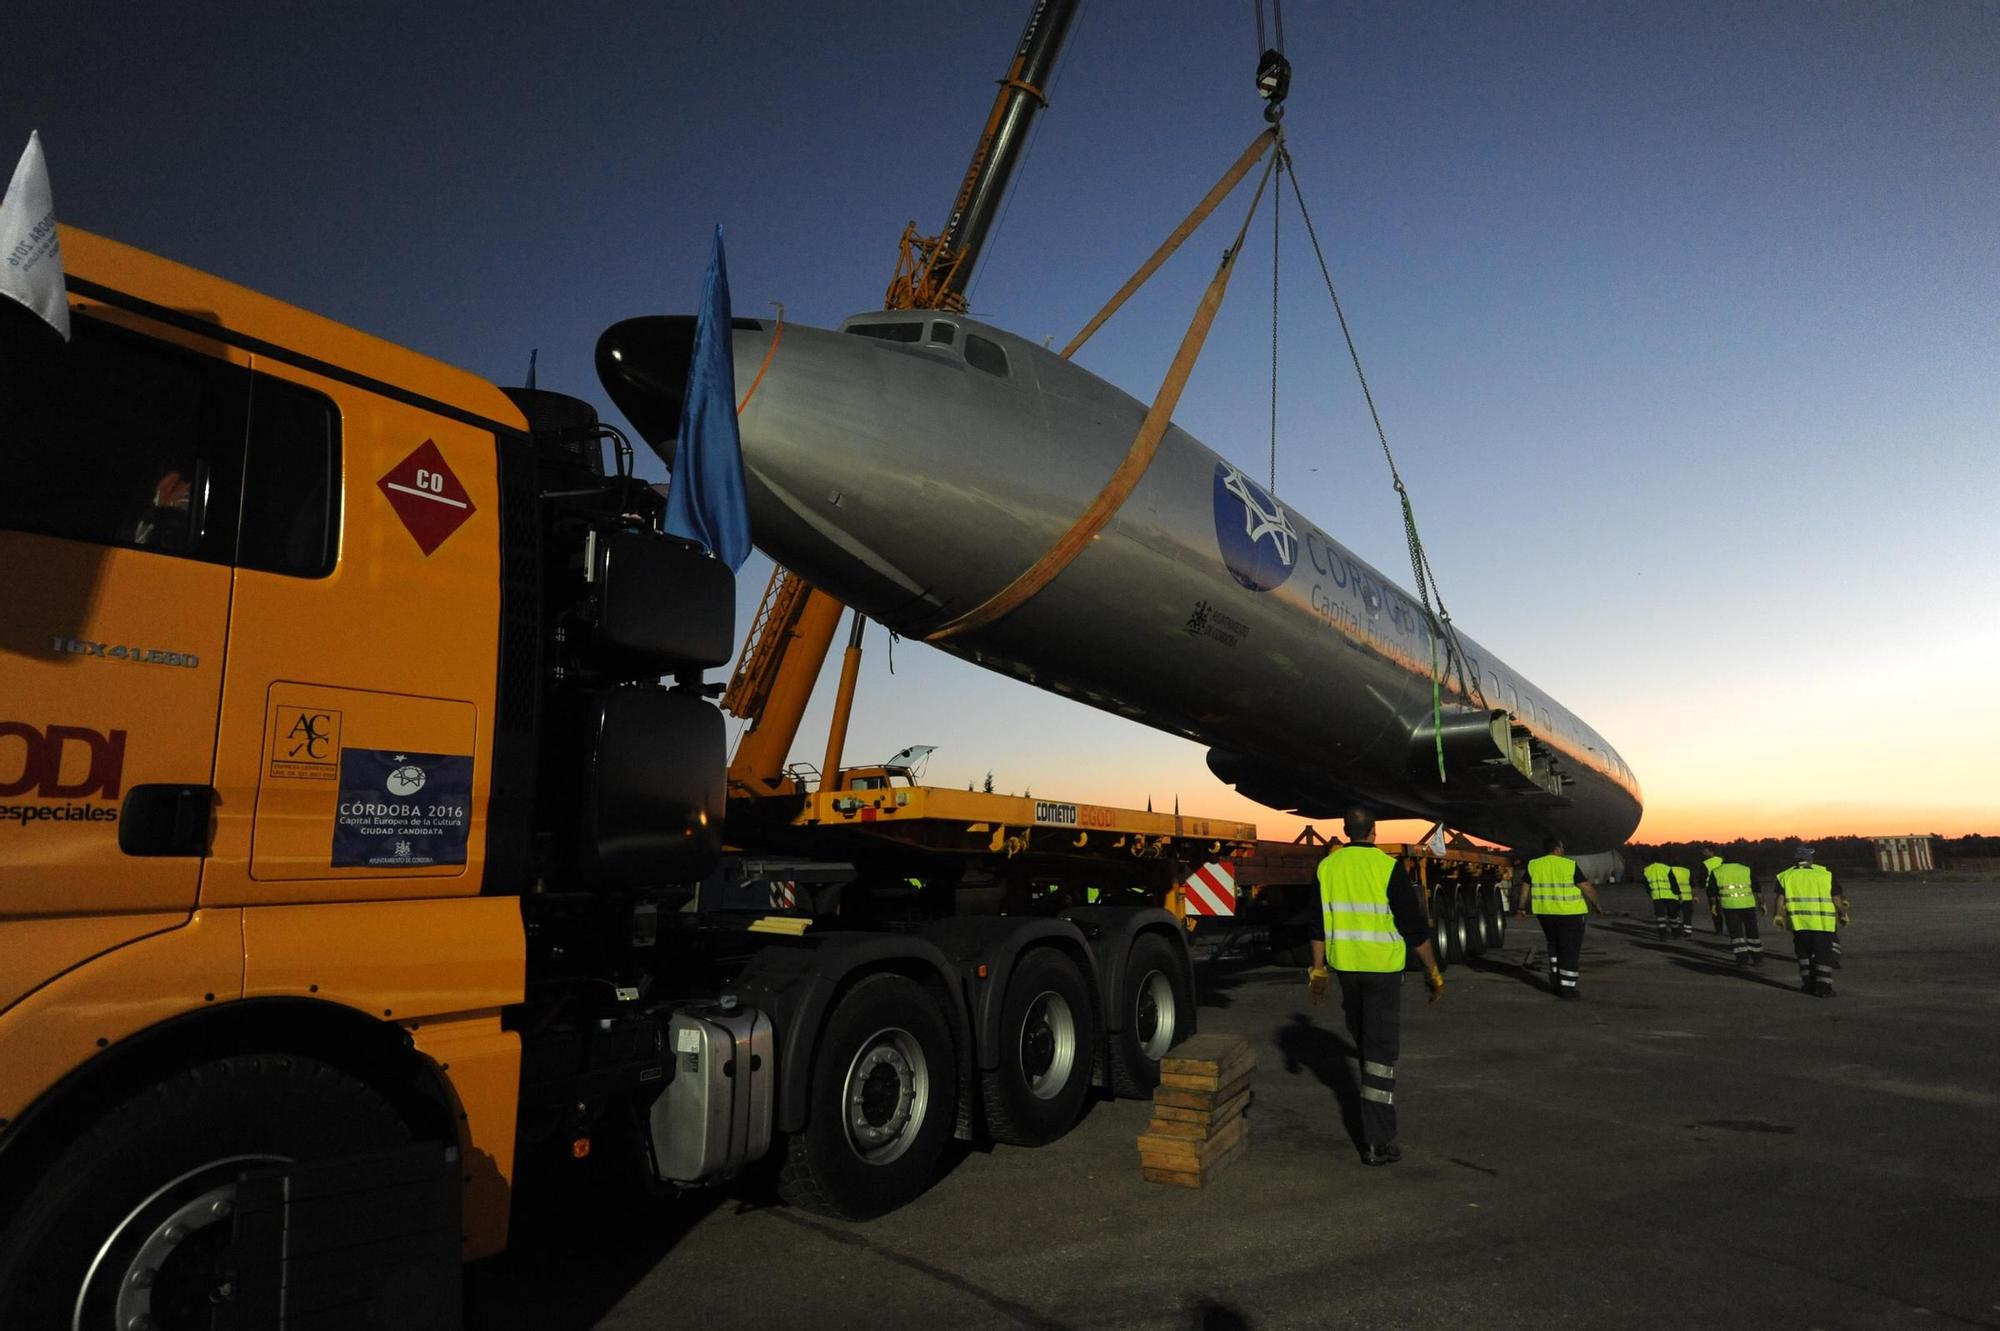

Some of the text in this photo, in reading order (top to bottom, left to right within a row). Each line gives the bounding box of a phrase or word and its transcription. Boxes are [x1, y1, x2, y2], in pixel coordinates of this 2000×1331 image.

[416, 469, 443, 492] CO
[1311, 583, 1362, 637] Capital
[340, 801, 463, 818] CÓRDOBA 2016
[339, 816, 462, 827] Capital Europea de la Cultura
[360, 827, 443, 836] CIUDAD CANDIDATA
